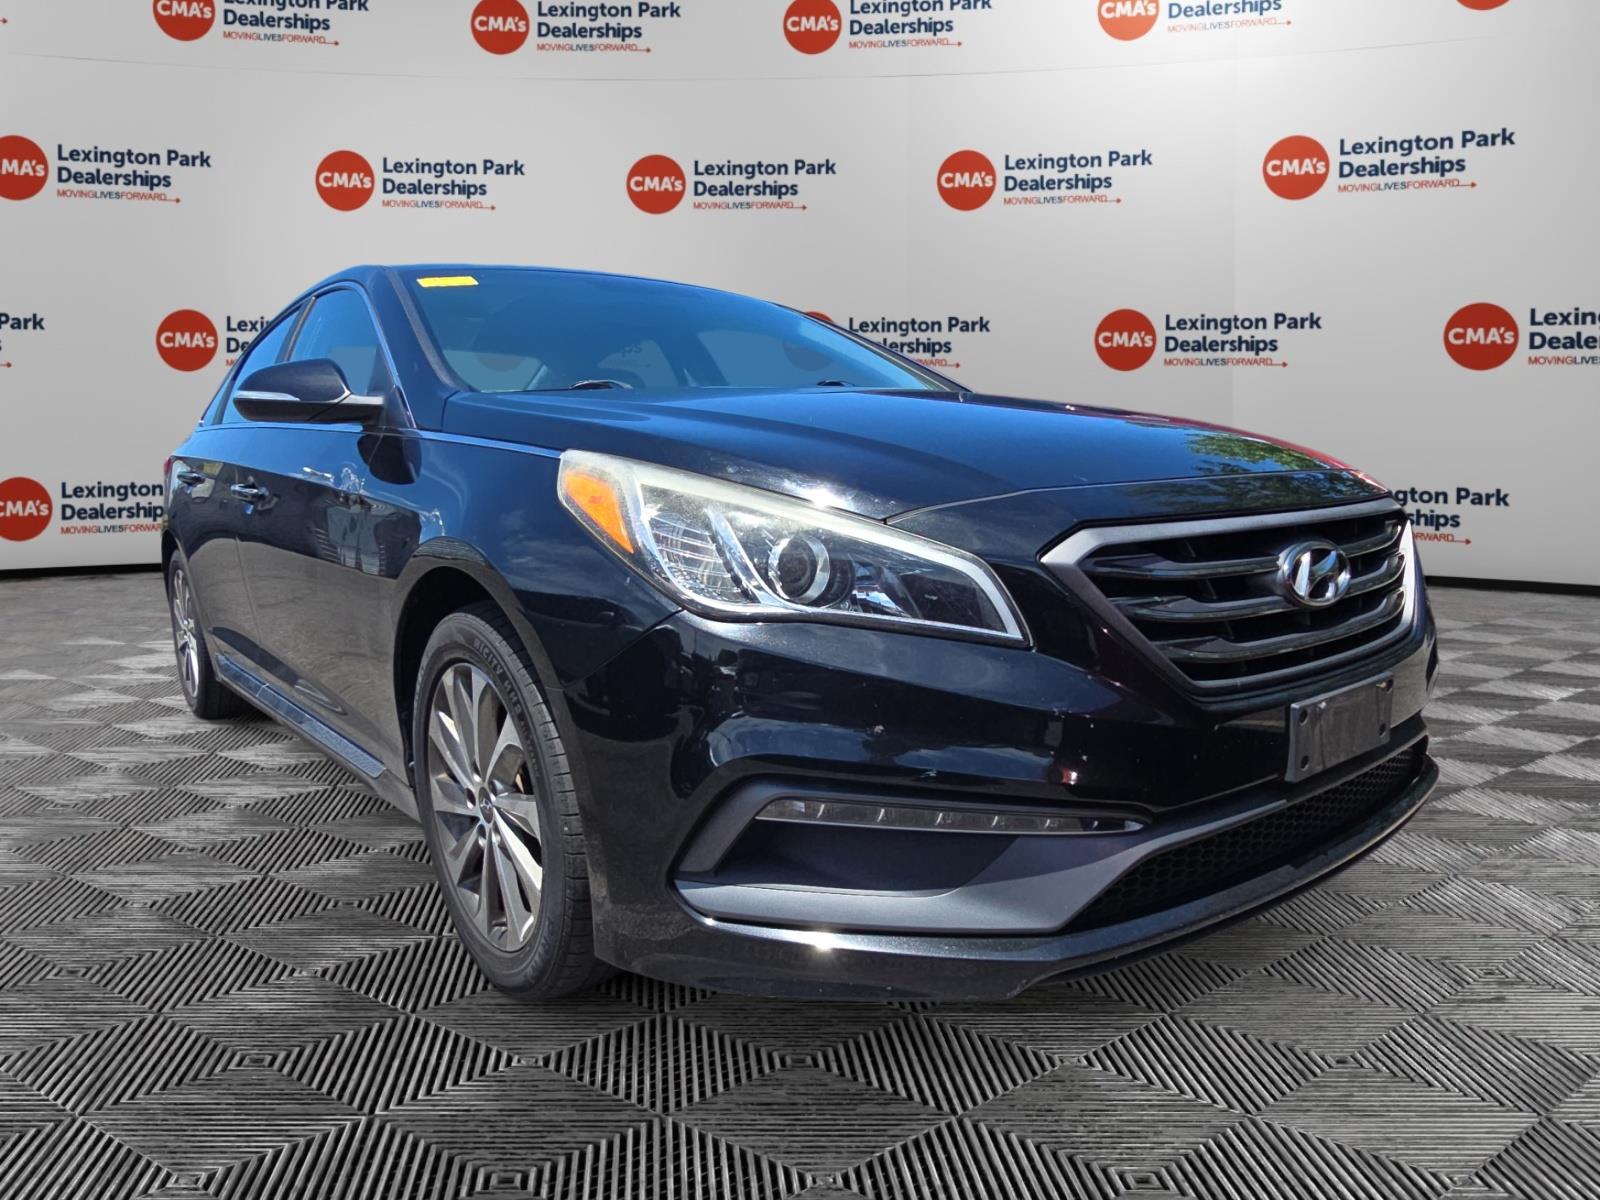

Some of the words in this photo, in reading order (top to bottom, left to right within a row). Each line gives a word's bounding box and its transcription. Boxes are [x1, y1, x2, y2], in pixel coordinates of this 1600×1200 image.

[157, 0, 211, 18] CMA's
[538, 1, 632, 22] Lexington
[639, 2, 680, 17] Park
[850, 0, 943, 17] Lexington
[1101, 0, 1156, 18] CMA's
[1169, 0, 1282, 18] Dealerships
[224, 9, 330, 34] Dealerships
[475, 16, 526, 32] CMA's
[787, 16, 838, 31] CMA's
[850, 17, 953, 36] Dealerships
[223, 31, 326, 44] MOVINGLIVESFORWARD
[538, 22, 642, 42] Dealerships
[537, 43, 637, 51] MOVINGLIVESFORWARD
[849, 38, 949, 48] MOVINGLIVESFORWARD
[1340, 135, 1453, 159] Lexington
[1462, 128, 1515, 148] Park
[58, 144, 160, 168] Lexington
[167, 150, 211, 167] Park
[1005, 154, 1101, 173] Lexington
[1109, 149, 1152, 167] Park
[2, 159, 44, 176] MA's
[383, 157, 477, 178] Lexington
[483, 159, 524, 175] Park
[695, 160, 788, 184] Lexington
[795, 159, 836, 175] Park
[1267, 158, 1326, 176] CMA's
[1339, 156, 1466, 178] Dealerships
[58, 166, 171, 191] Dealerships
[319, 172, 371, 188] CMA's
[630, 176, 682, 191] CMA's
[941, 172, 993, 188] CMA's
[1005, 174, 1112, 193] Dealerships
[1338, 178, 1460, 193] MOVINGLIVESFORWARD
[57, 189, 167, 201] MOVINGLIVESFORWARD
[383, 178, 487, 199] Dealerships
[694, 181, 798, 200] Dealerships
[382, 199, 483, 209] MOVINGLIVESFORWARD
[693, 201, 794, 210] MOVINGLIVESFORWARD
[1004, 194, 1107, 205] MOVINGLIVESFORWARD
[0, 313, 44, 330] Park
[1165, 314, 1266, 336] Lexington
[1274, 312, 1321, 329] Park
[1530, 307, 1600, 326] Lexin
[849, 317, 942, 337] Lexington
[948, 317, 990, 332] Park
[1448, 327, 1514, 344] CMA's
[160, 332, 214, 348] CMA's
[1099, 332, 1153, 347] CMA's
[1165, 335, 1278, 356] Dealerships
[1529, 331, 1600, 349] Deale
[1163, 357, 1273, 367] MOVINGLIVESFORWARD
[1528, 356, 1600, 365] MOVINGLIVE
[62, 481, 163, 501] Lexington
[1456, 487, 1509, 506] Park
[61, 502, 164, 522] Dealership
